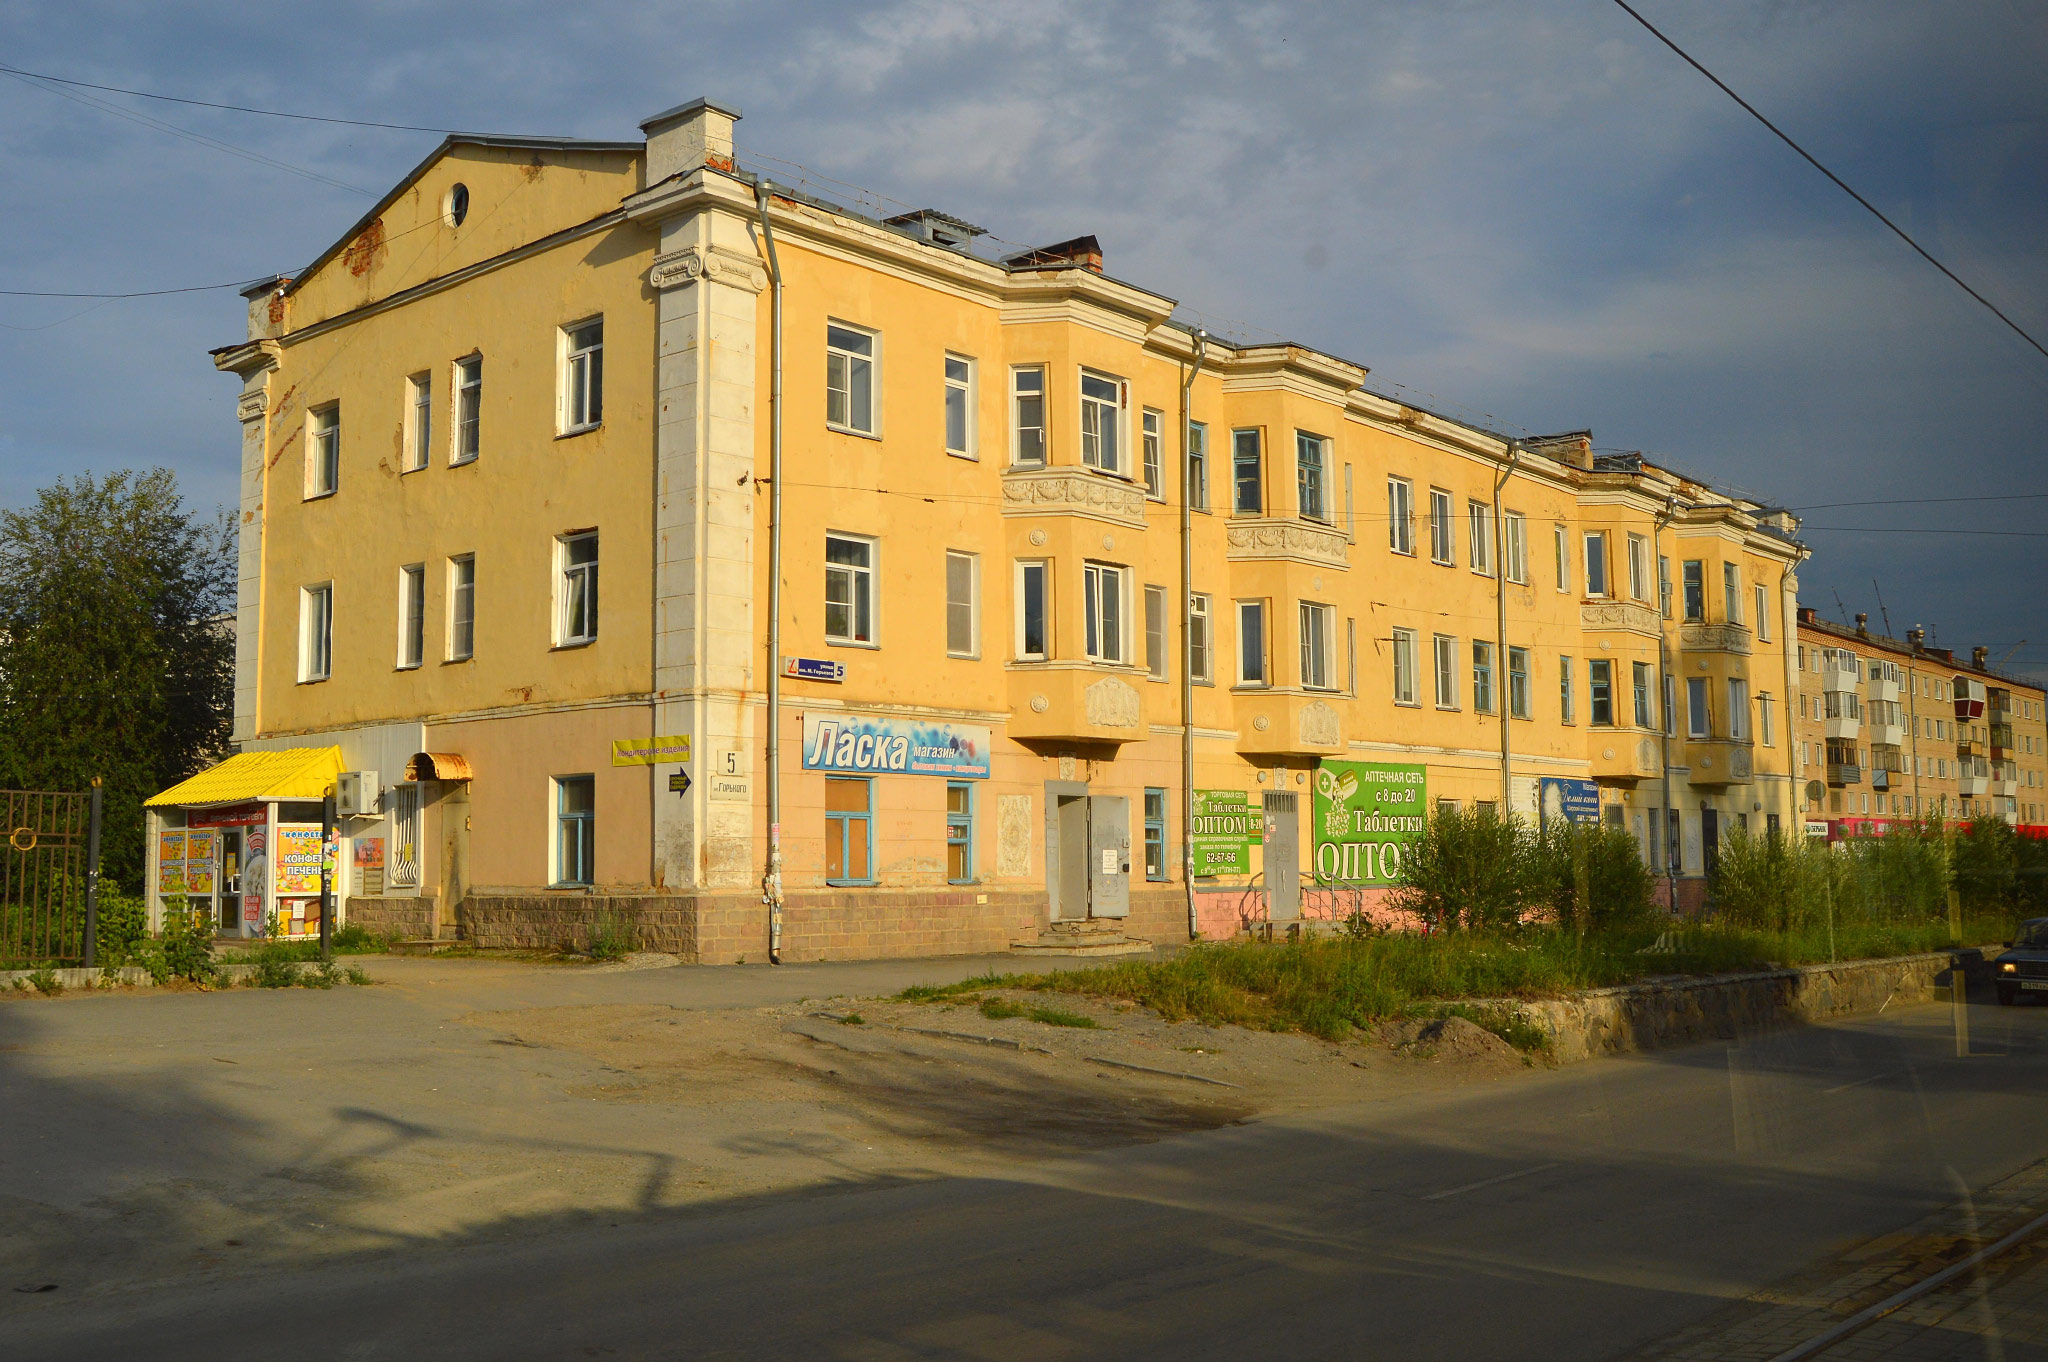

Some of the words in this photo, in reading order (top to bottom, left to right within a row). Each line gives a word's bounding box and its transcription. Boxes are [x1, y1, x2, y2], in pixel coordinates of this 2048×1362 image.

[836, 665, 844, 677] 5
[808, 720, 909, 771] Ласка
[913, 745, 956, 759] магазин
[727, 752, 736, 774] 5
[1364, 770, 1404, 783] АПТЕЧНАЯ
[1405, 772, 1424, 784] СЕТЬ
[1376, 791, 1382, 802] с
[1383, 788, 1389, 802] 8
[1390, 791, 1403, 805] до
[1405, 788, 1416, 803] 20
[1206, 801, 1247, 813] Таблетки
[1193, 816, 1247, 834] ОПТОМ
[1353, 809, 1423, 832] Таблетки
[284, 854, 323, 863] КОНФЕТ
[287, 866, 323, 875] ПЕЧЕНЬ
